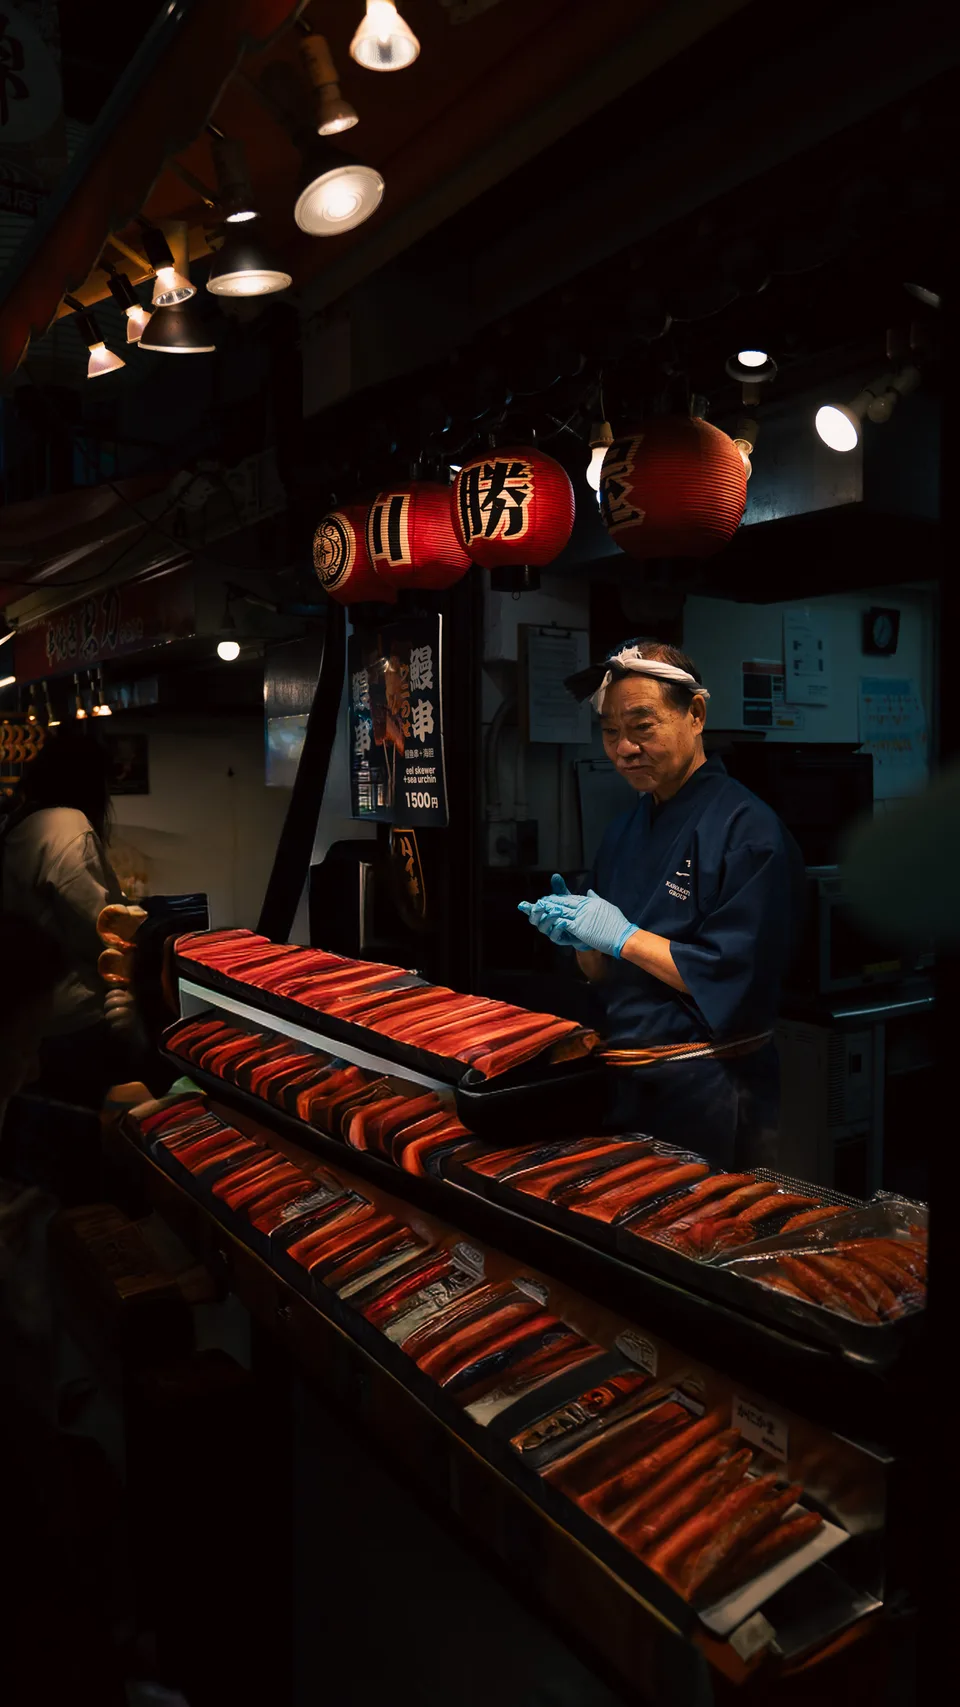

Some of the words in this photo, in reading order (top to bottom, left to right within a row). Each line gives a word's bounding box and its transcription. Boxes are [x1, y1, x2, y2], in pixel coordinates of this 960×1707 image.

[458, 458, 534, 546] 勝
[409, 645, 435, 743] 鰻串
[406, 766, 414, 775] eel
[415, 766, 435, 775] skewer
[418, 775, 436, 783] urchin
[405, 792, 438, 808] 1500円
